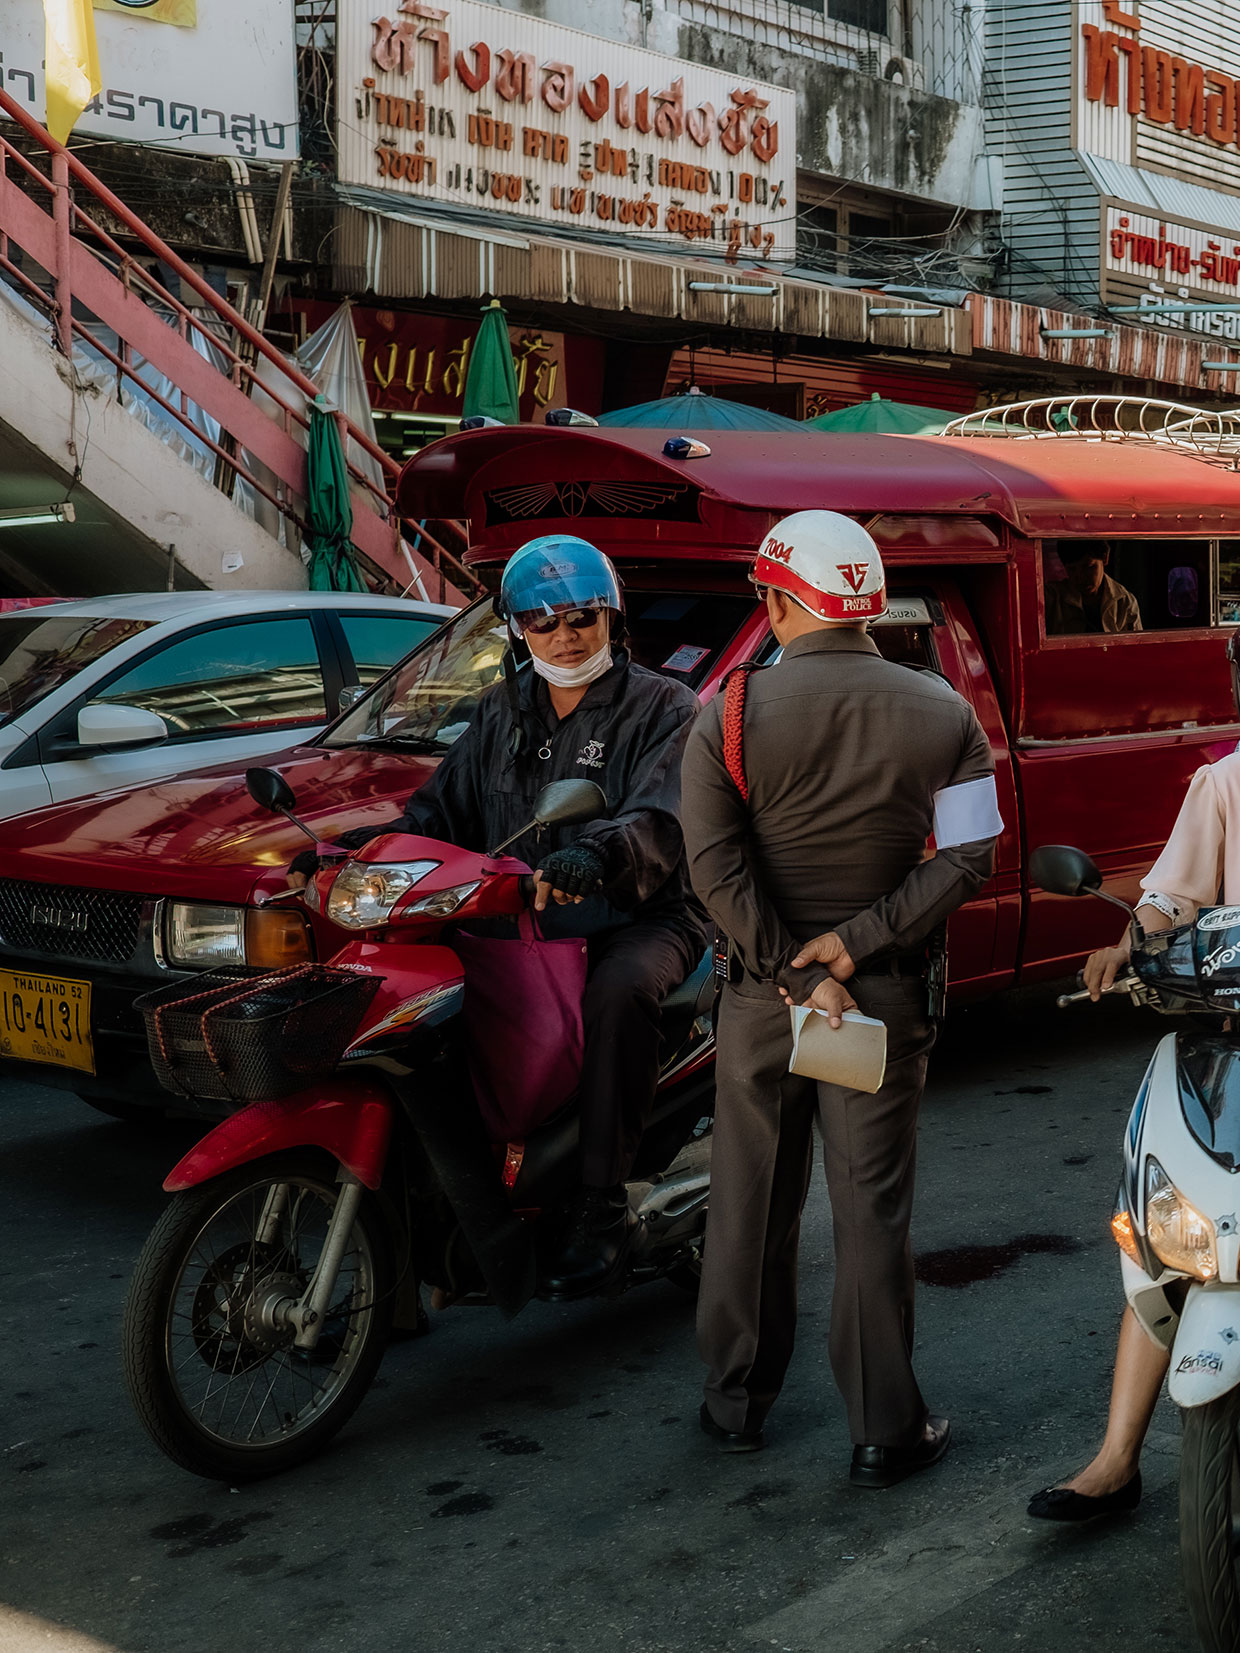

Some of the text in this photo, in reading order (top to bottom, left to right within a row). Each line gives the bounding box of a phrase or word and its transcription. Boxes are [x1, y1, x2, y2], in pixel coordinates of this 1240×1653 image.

[371, 0, 779, 163] ห้างทองแสงชัย
[764, 538, 794, 563] 7004
[30, 904, 90, 932] ISUZU
[13, 977, 82, 999] THAILAND 52
[3, 991, 83, 1045] 10-4131
